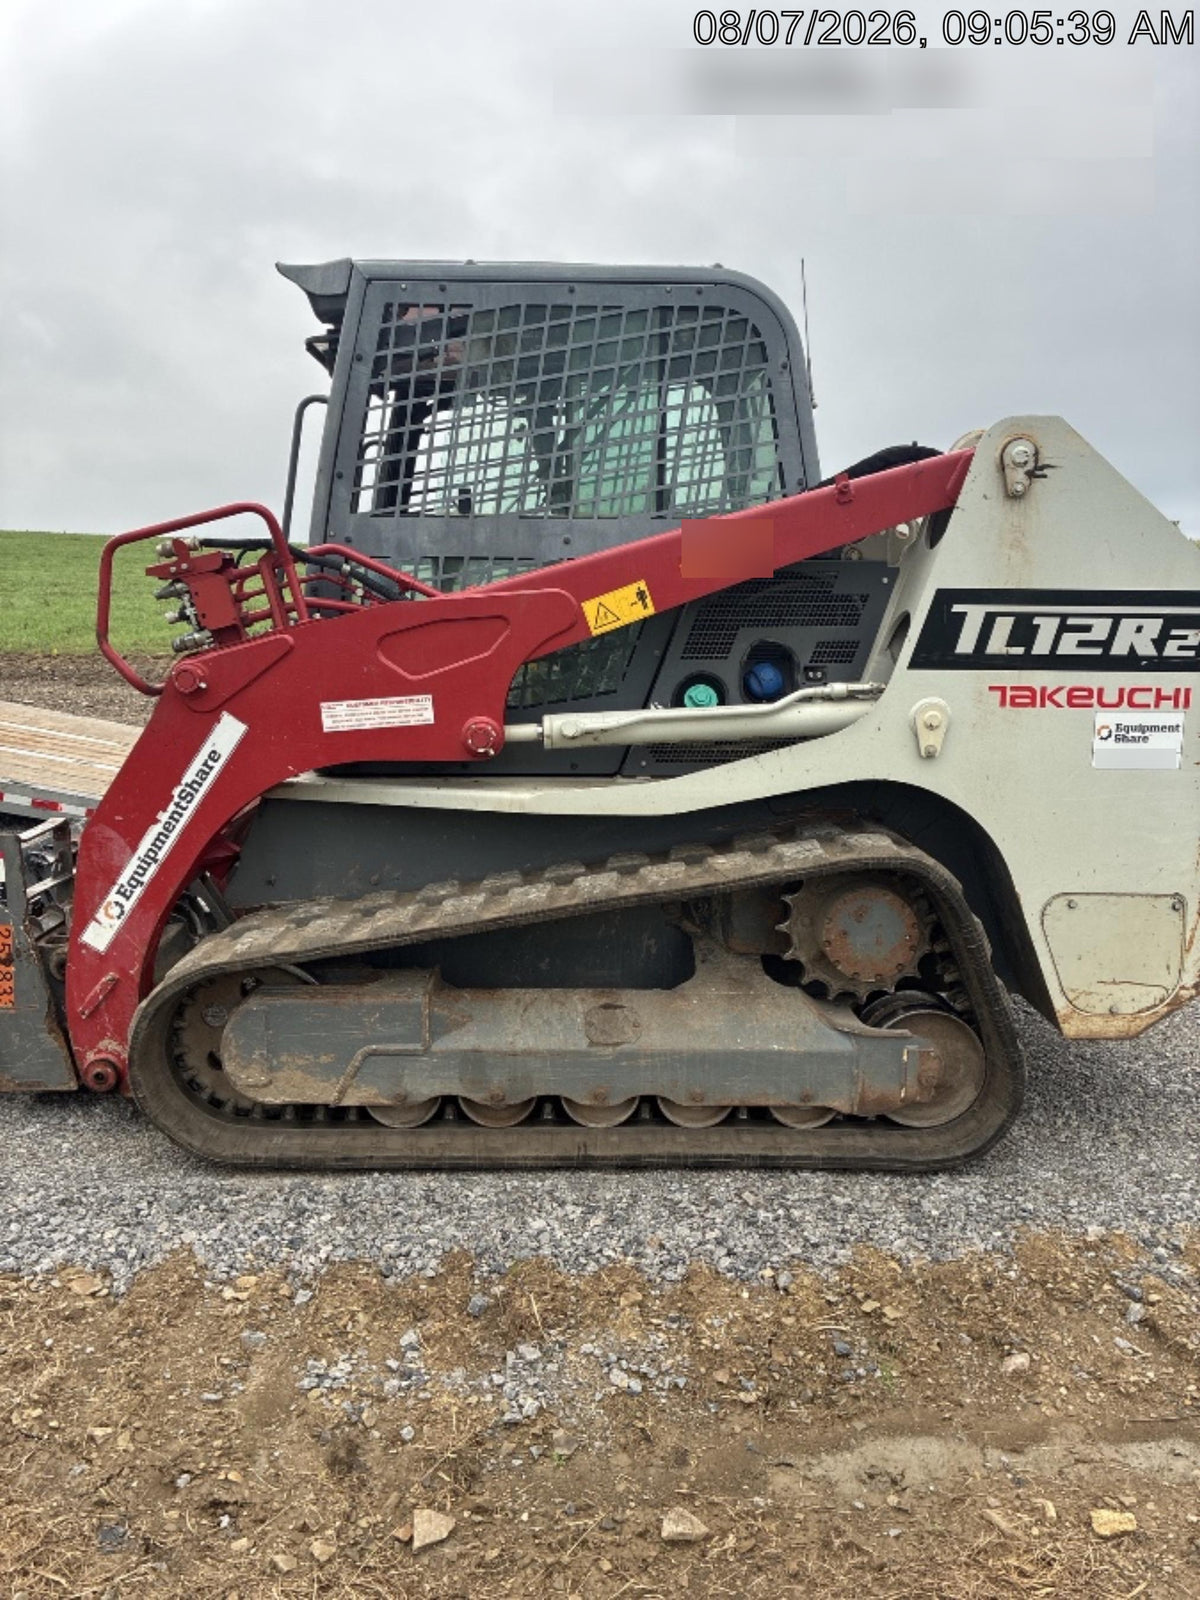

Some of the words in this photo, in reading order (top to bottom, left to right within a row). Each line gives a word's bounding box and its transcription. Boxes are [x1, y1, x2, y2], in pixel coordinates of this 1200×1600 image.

[988, 685, 1192, 709] TAKEUCHI
[1115, 722, 1181, 735] Equipment
[1114, 733, 1150, 744] Share
[115, 748, 222, 902] EquipmentShare
